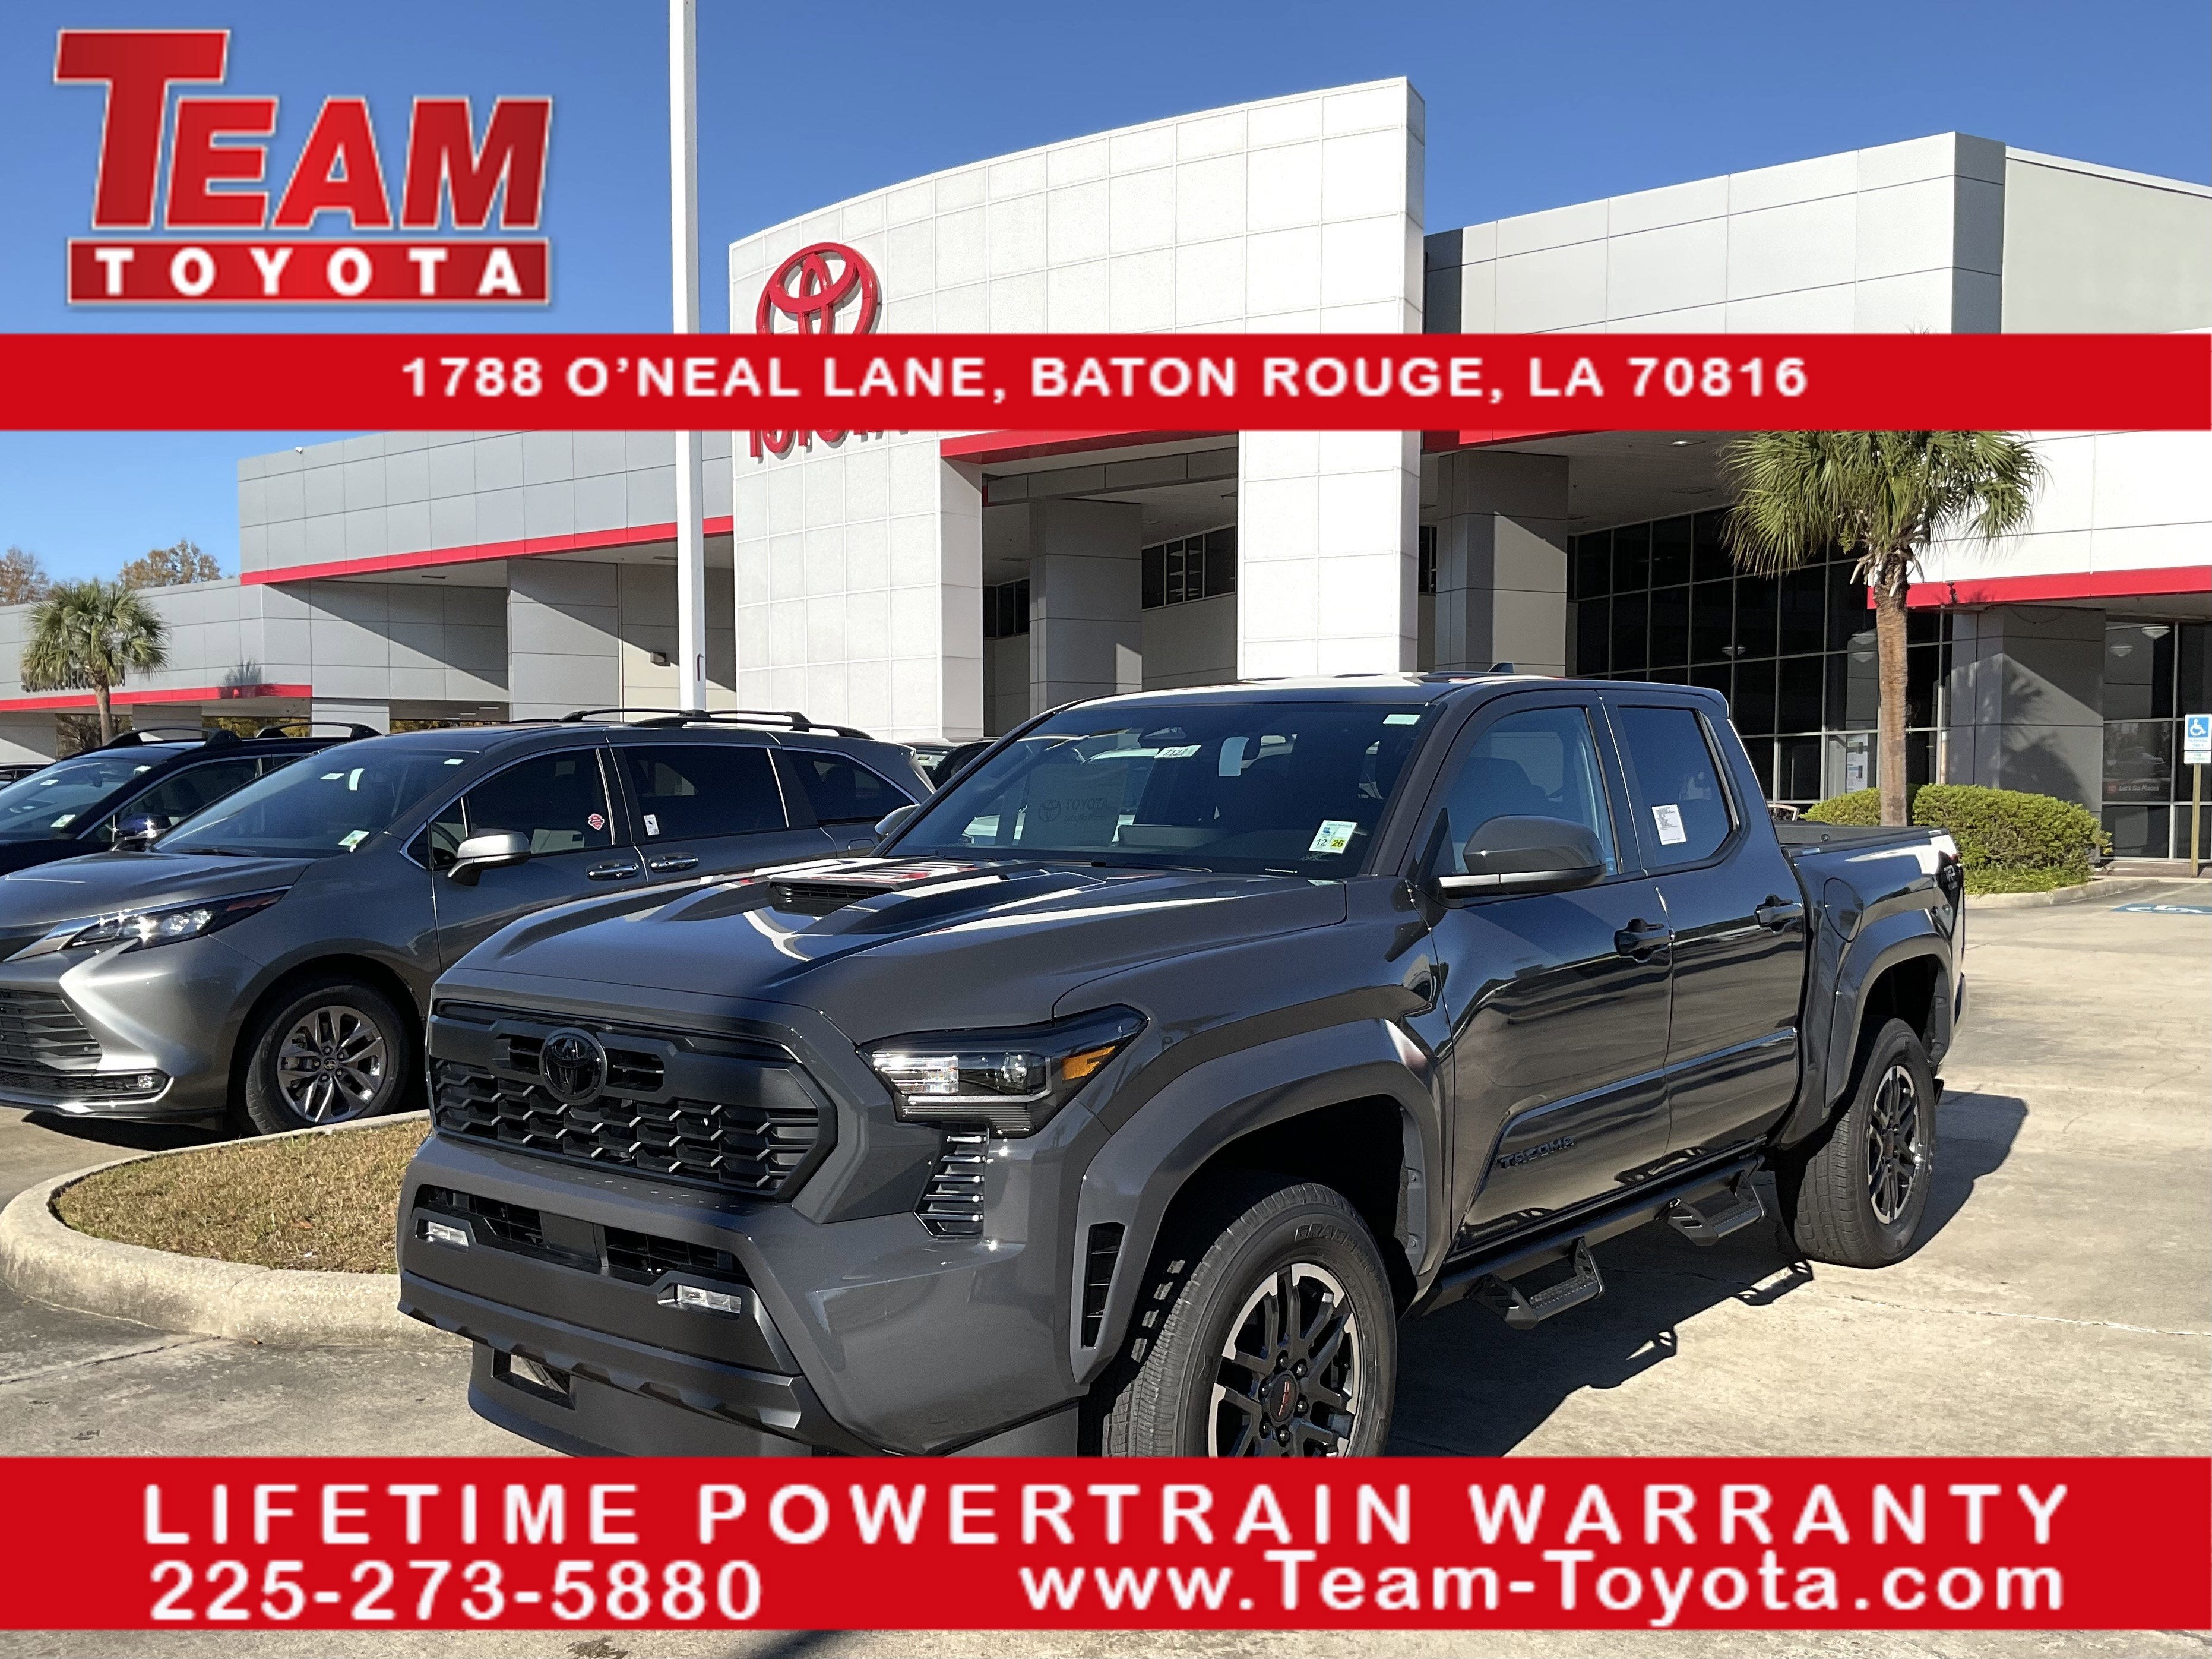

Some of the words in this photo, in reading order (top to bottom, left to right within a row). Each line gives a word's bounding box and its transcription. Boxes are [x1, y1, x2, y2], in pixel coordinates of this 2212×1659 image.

[1066, 797, 1110, 810] TOYOTA
[1317, 838, 1327, 846] 12
[1331, 839, 1344, 848] 26
[1498, 1135, 1575, 1169] TACOMA
[1294, 1223, 1376, 1276] GRABBER
